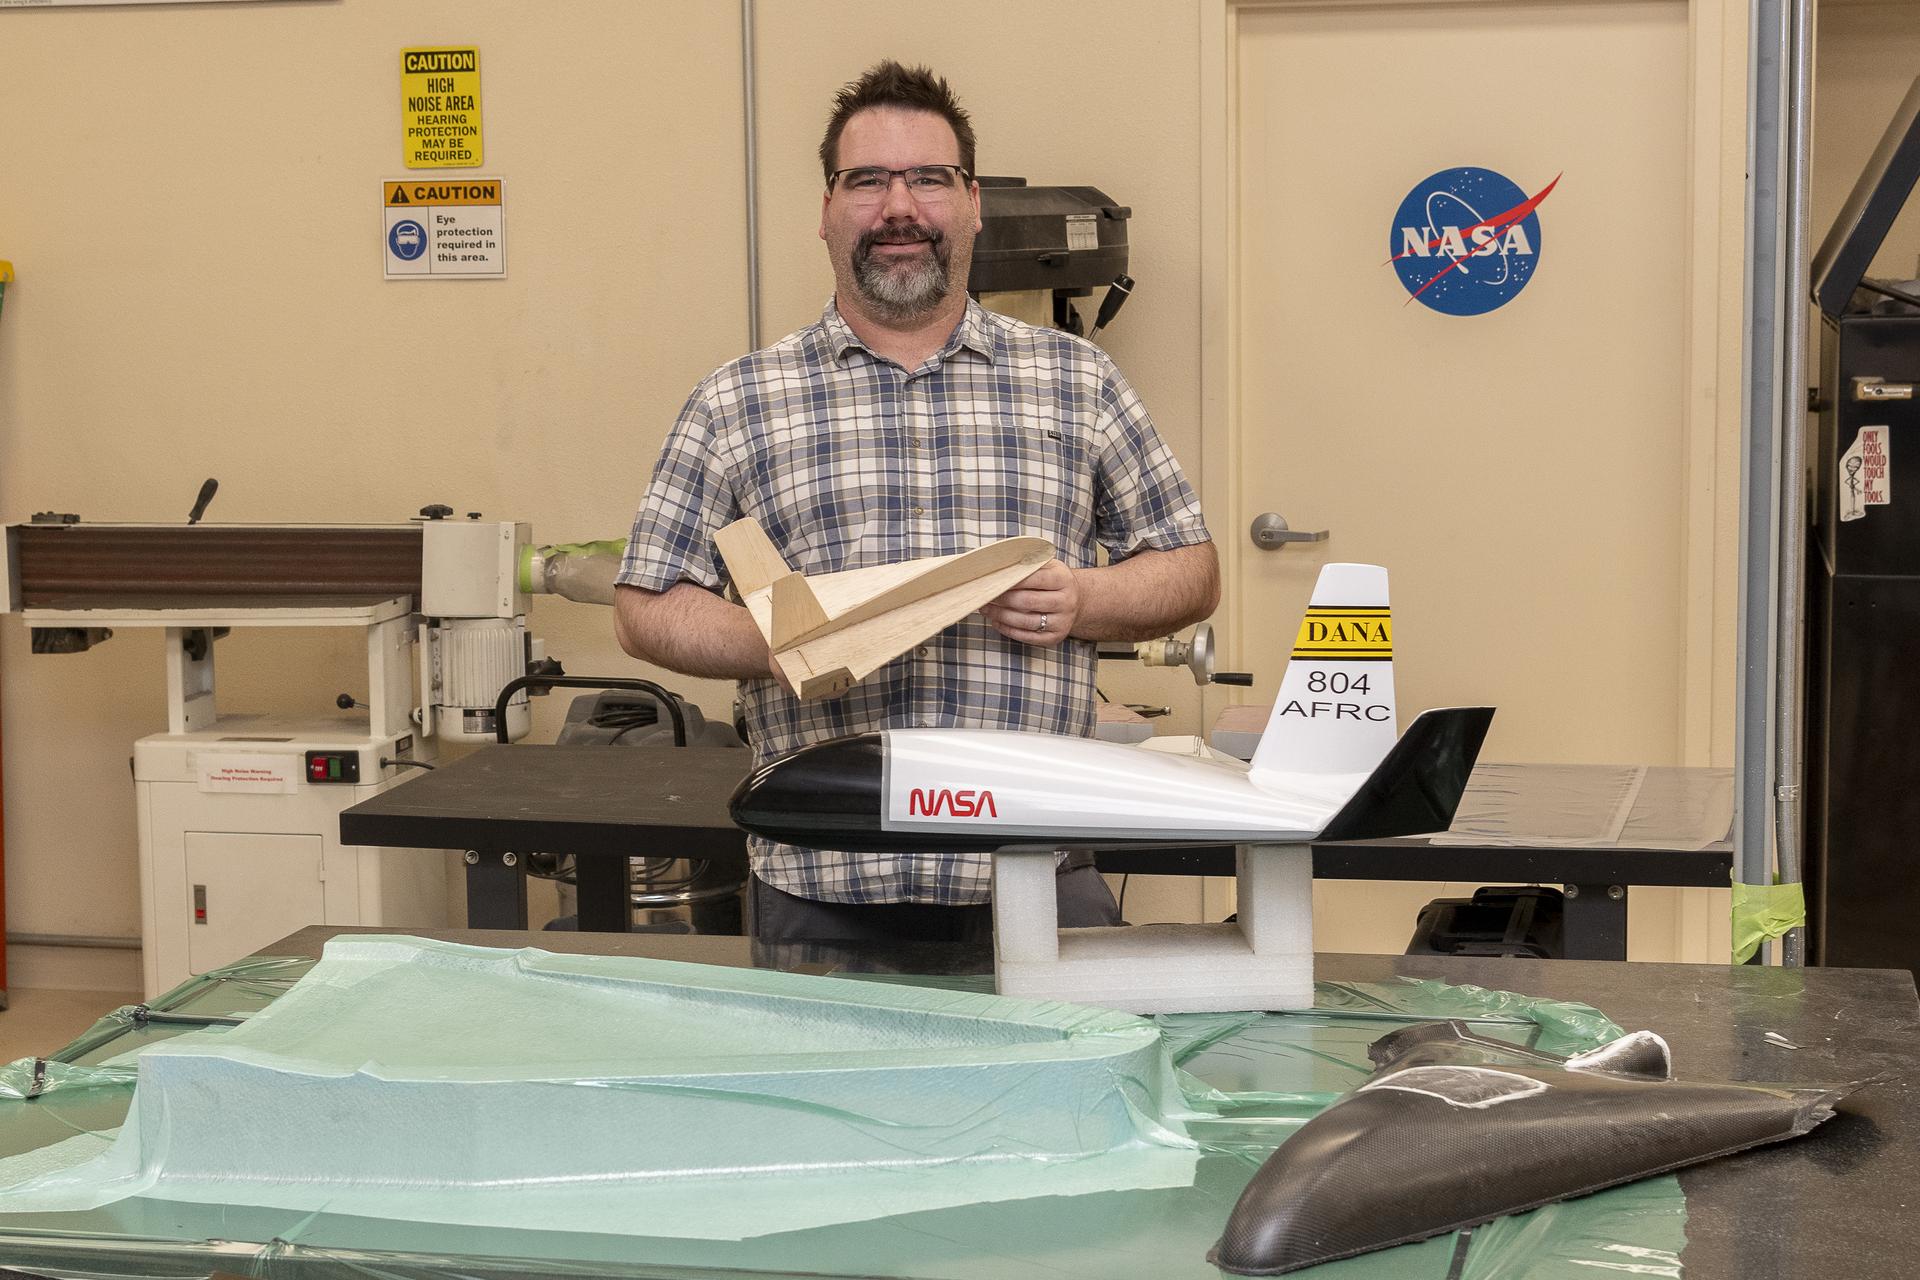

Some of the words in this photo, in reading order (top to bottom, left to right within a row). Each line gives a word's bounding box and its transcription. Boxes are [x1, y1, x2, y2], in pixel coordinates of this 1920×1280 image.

[407, 53, 474, 71] CAUTION
[427, 77, 454, 93] HIGH
[408, 96, 442, 112] NOISE
[445, 95, 475, 111] AREA
[417, 114, 467, 125] HEARING
[408, 126, 477, 137] PROTECTION
[422, 139, 446, 149] MAY
[449, 138, 464, 148] BE
[415, 150, 472, 161] REQUIRED
[414, 186, 495, 200] CAUTION
[436, 215, 456, 225] Eye
[437, 227, 493, 238] protection
[437, 240, 482, 250] required
[486, 240, 496, 249] in
[1401, 224, 1533, 258] NASA
[438, 253, 457, 262] this
[461, 254, 489, 262] area.
[1862, 431, 1879, 442] ONLY
[1863, 442, 1882, 454] FOOLS
[1863, 455, 1887, 467] WOULD
[1864, 466, 1885, 479] TOUCH
[1864, 479, 1874, 491] MY
[1306, 621, 1390, 642] DANA
[1307, 671, 1371, 695] 804
[1280, 700, 1391, 722] AFRC
[909, 788, 998, 818] NASA
